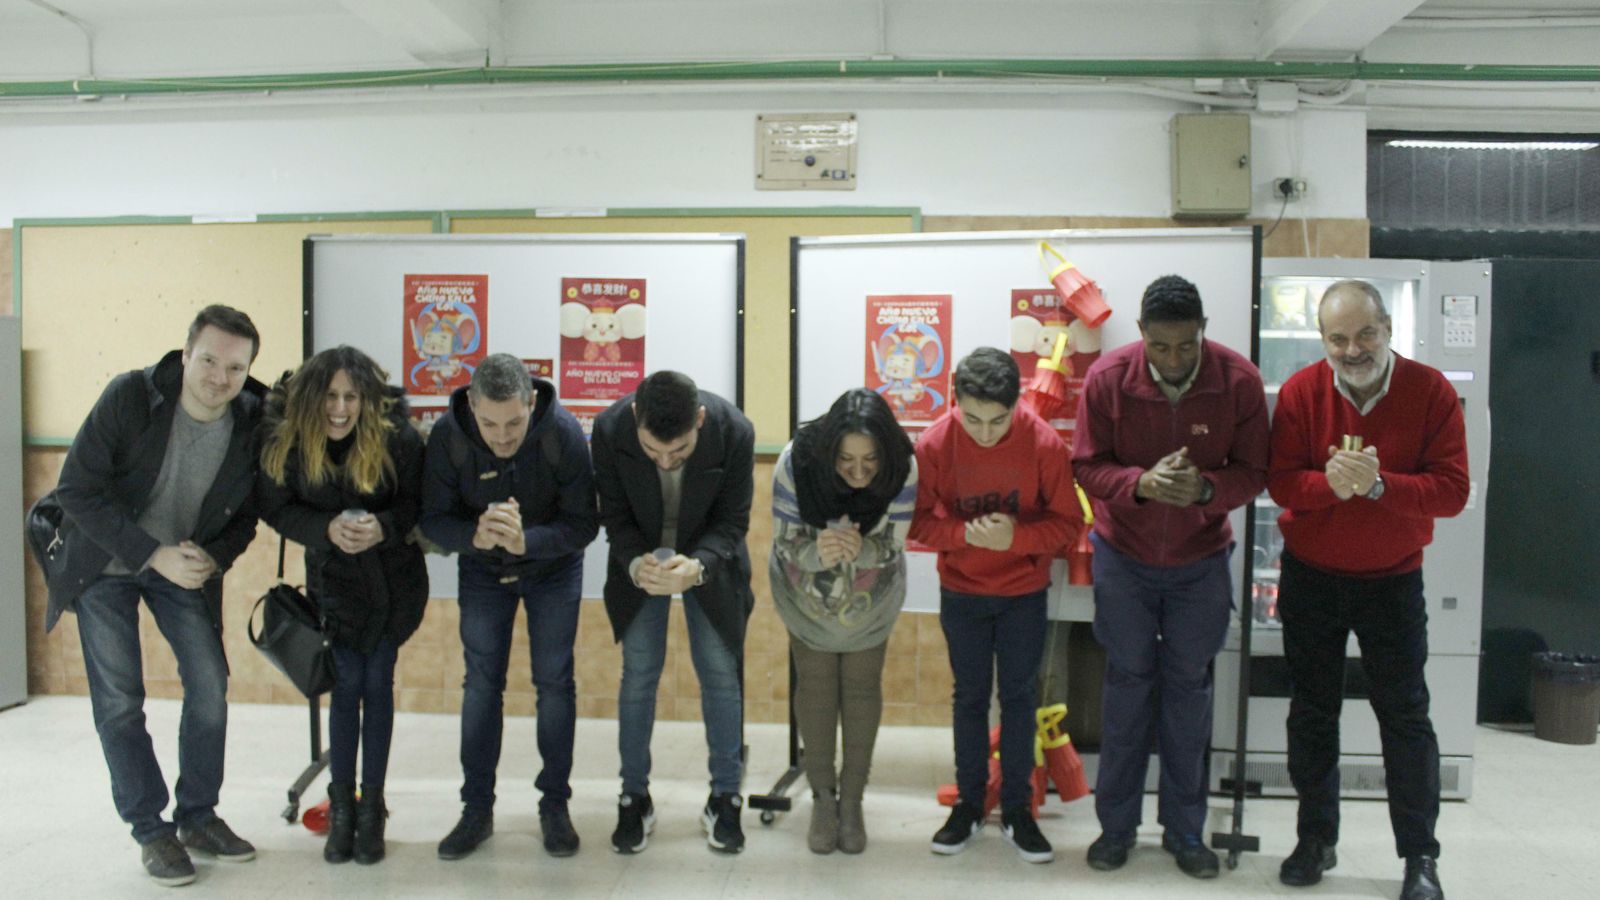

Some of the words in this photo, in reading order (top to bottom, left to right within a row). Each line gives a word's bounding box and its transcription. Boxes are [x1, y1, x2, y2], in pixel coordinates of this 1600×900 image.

[417, 286, 438, 296] AÑO
[439, 287, 474, 296] NUEVO
[415, 295, 446, 304] CHINO
[447, 295, 462, 304] EN
[463, 295, 476, 304] LA
[879, 307, 901, 316] AÑO
[902, 307, 938, 316] NUEVO
[876, 316, 909, 325] CHINO
[910, 316, 925, 325] EN
[926, 316, 940, 325] LA
[566, 368, 584, 378] AÑO
[585, 370, 612, 378] NUEVO
[613, 370, 639, 378] CHINO
[584, 376, 595, 384] EN
[596, 376, 607, 384] LA
